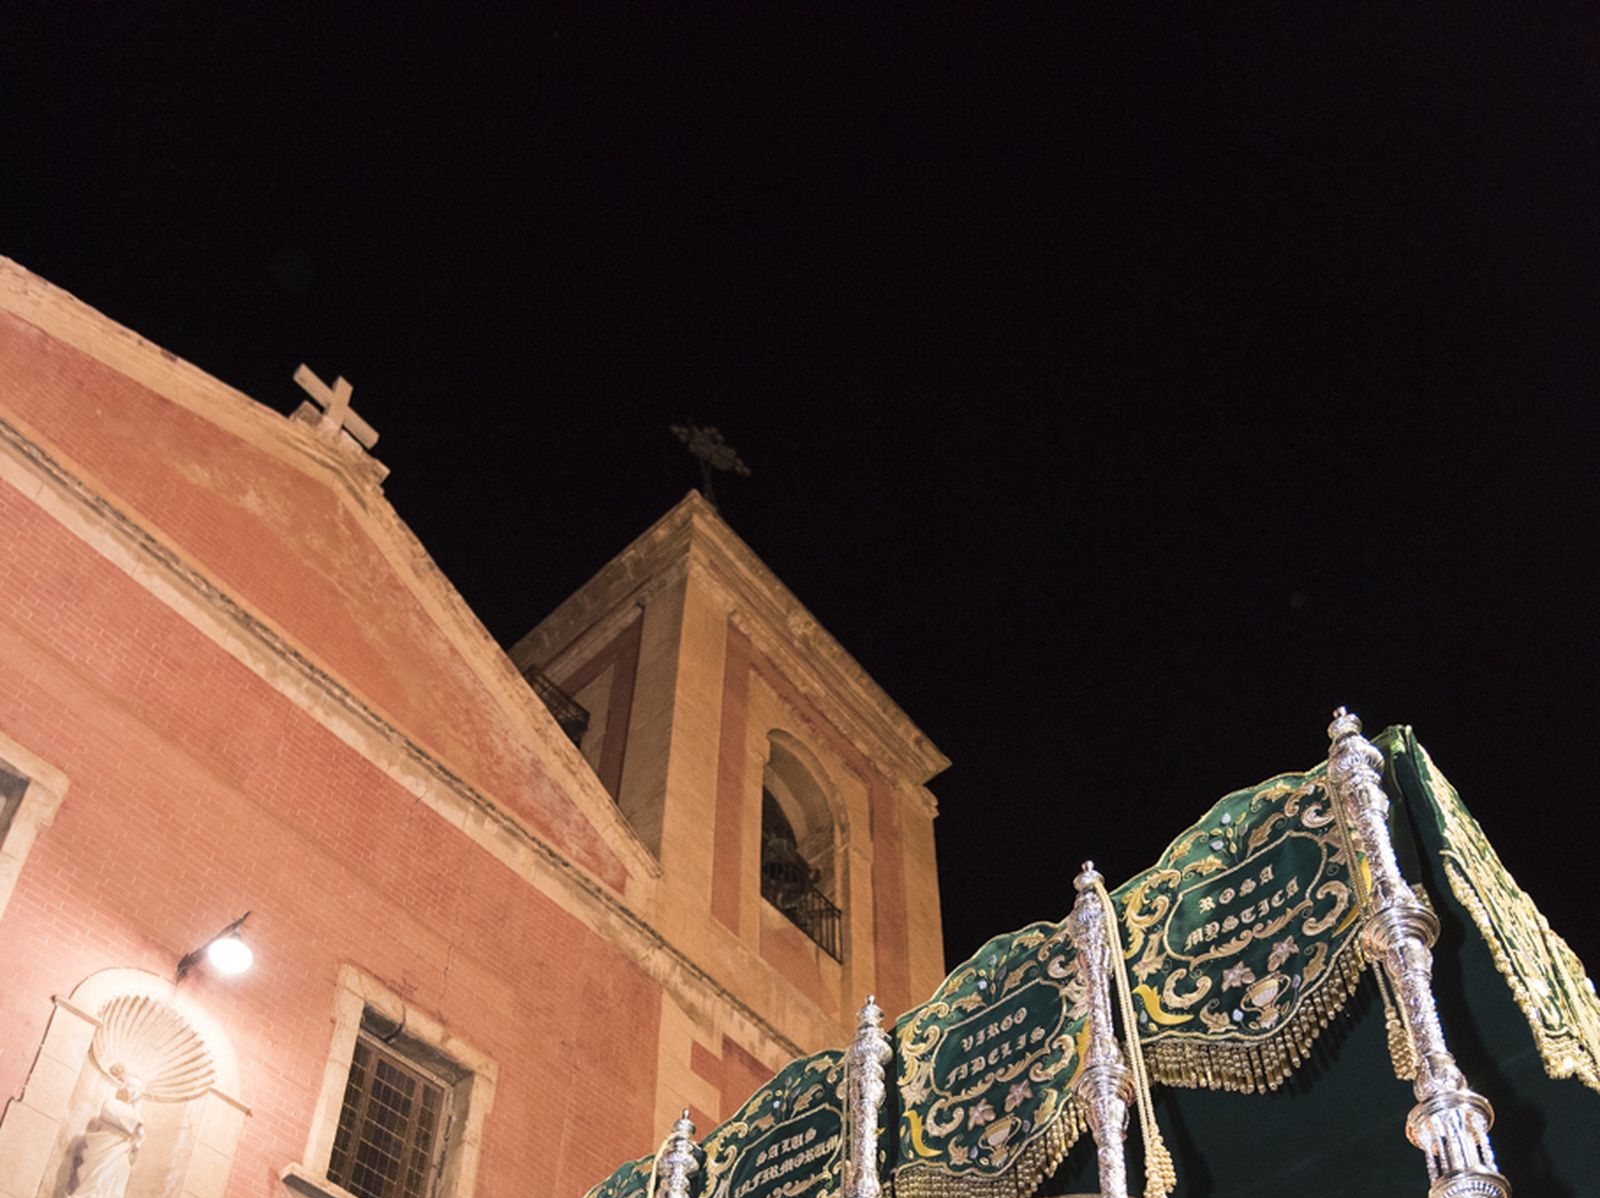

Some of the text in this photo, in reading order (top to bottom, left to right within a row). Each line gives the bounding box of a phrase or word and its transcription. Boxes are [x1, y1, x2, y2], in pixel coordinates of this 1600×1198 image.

[1199, 864, 1274, 914] ROSA
[960, 1007, 1027, 1052] VIRGO
[944, 1026, 1045, 1089] FIDELIS
[755, 1127, 817, 1167] SALUS
